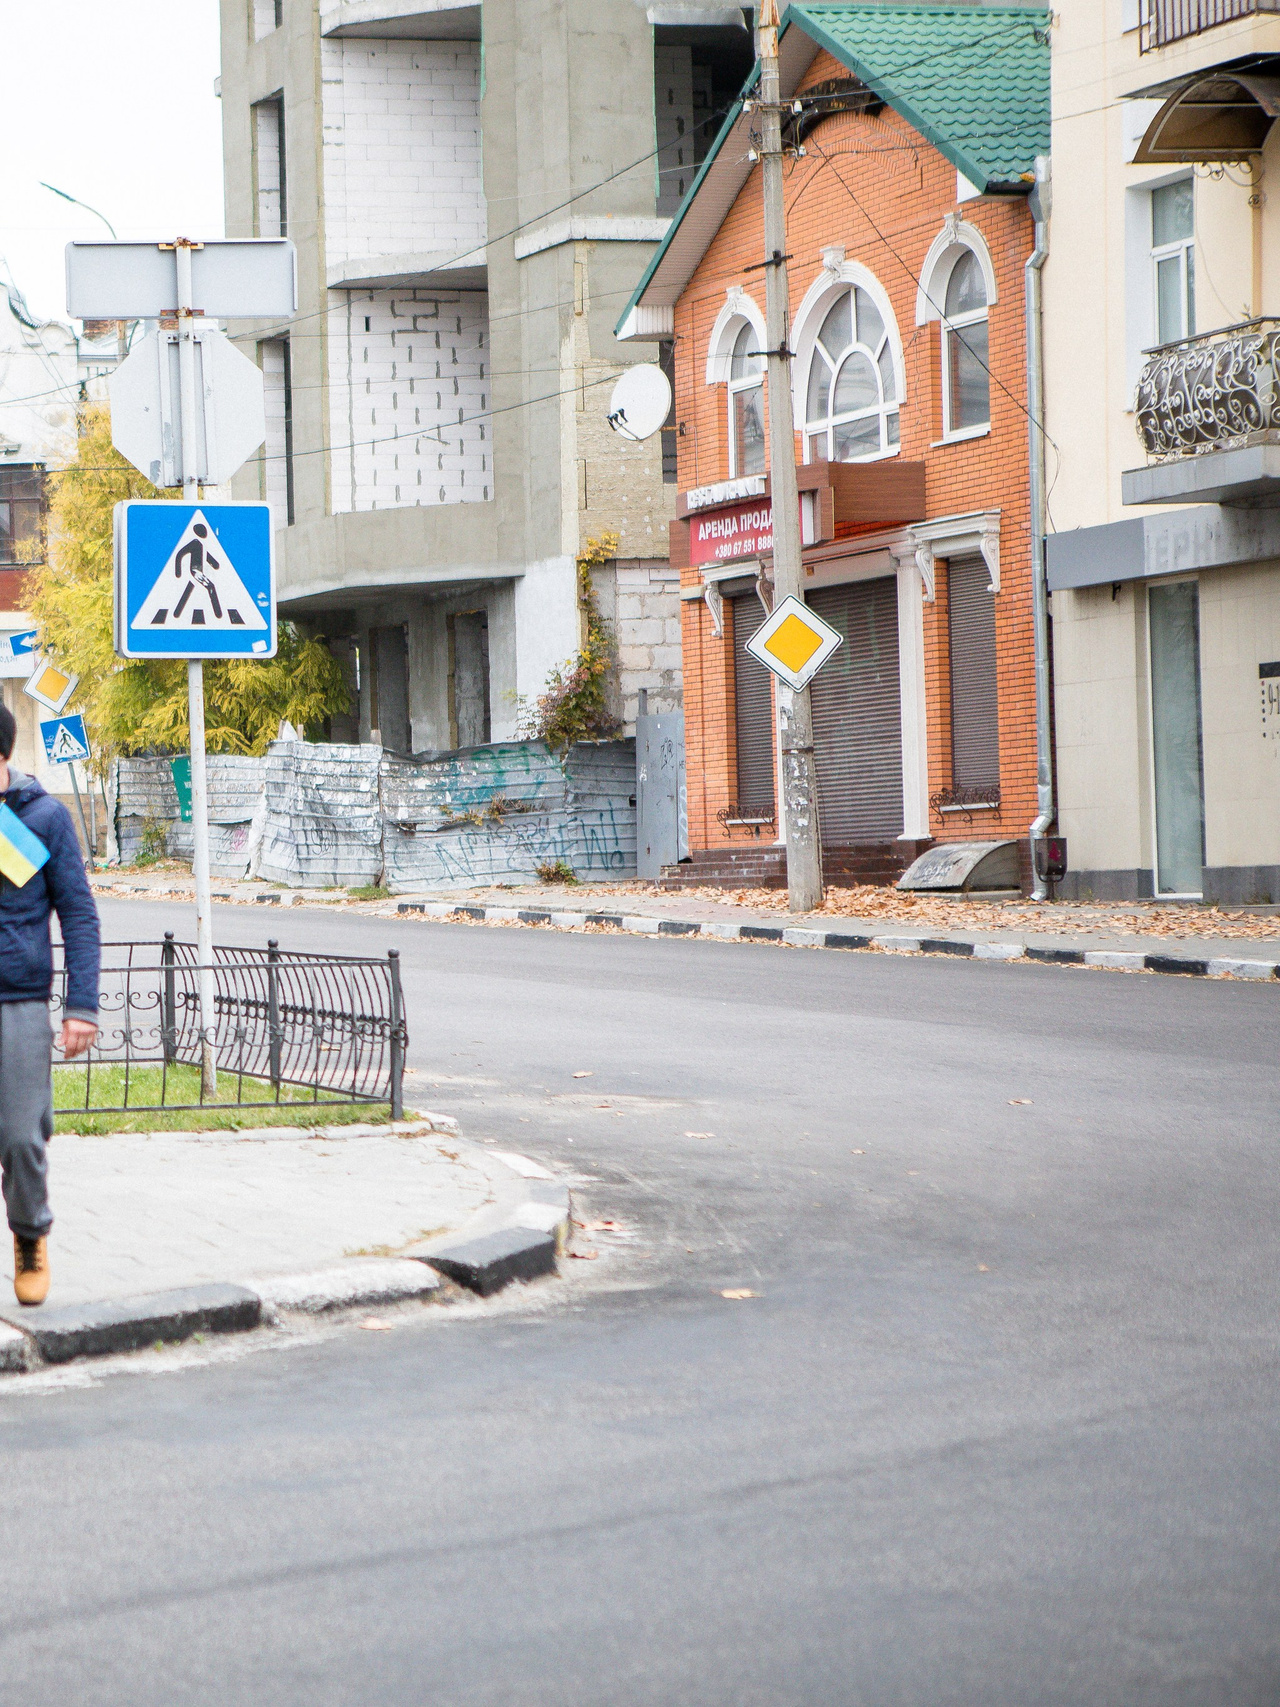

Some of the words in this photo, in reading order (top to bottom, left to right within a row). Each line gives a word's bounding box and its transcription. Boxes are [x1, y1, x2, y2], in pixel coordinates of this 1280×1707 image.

[698, 516, 738, 541] АРЕНДА
[715, 543, 732, 558] +380
[733, 541, 742, 556] 67
[743, 538, 755, 553] 551
